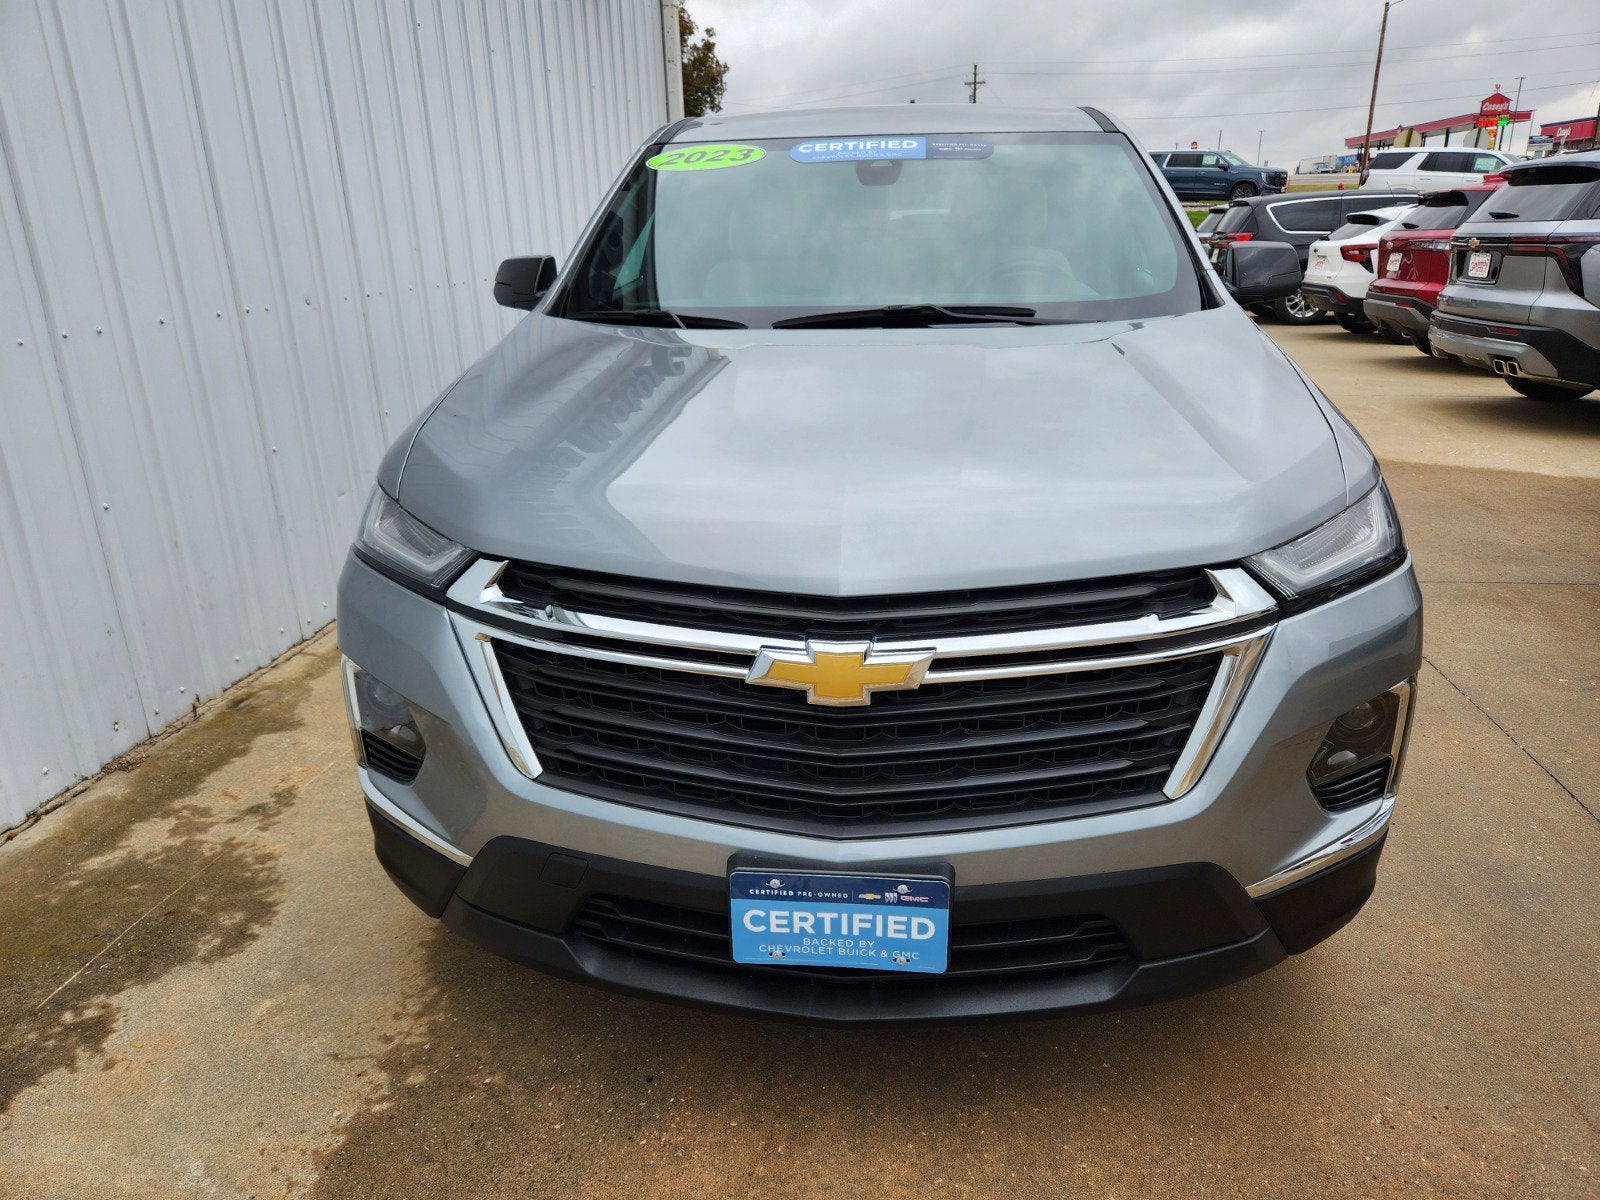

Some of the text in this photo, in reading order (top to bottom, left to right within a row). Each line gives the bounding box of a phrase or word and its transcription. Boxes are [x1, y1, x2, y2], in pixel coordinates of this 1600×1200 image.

[1482, 102, 1509, 111] Casey's
[798, 140, 918, 153] CERTIFIED
[658, 148, 754, 167] 2023
[797, 891, 848, 899] PRE-OWNED
[900, 895, 929, 903] GMC
[743, 909, 936, 940] CERTIFIED
[803, 937, 875, 948] BACKED BY
[759, 944, 919, 960] CHEVROLET BUICK & GMC
